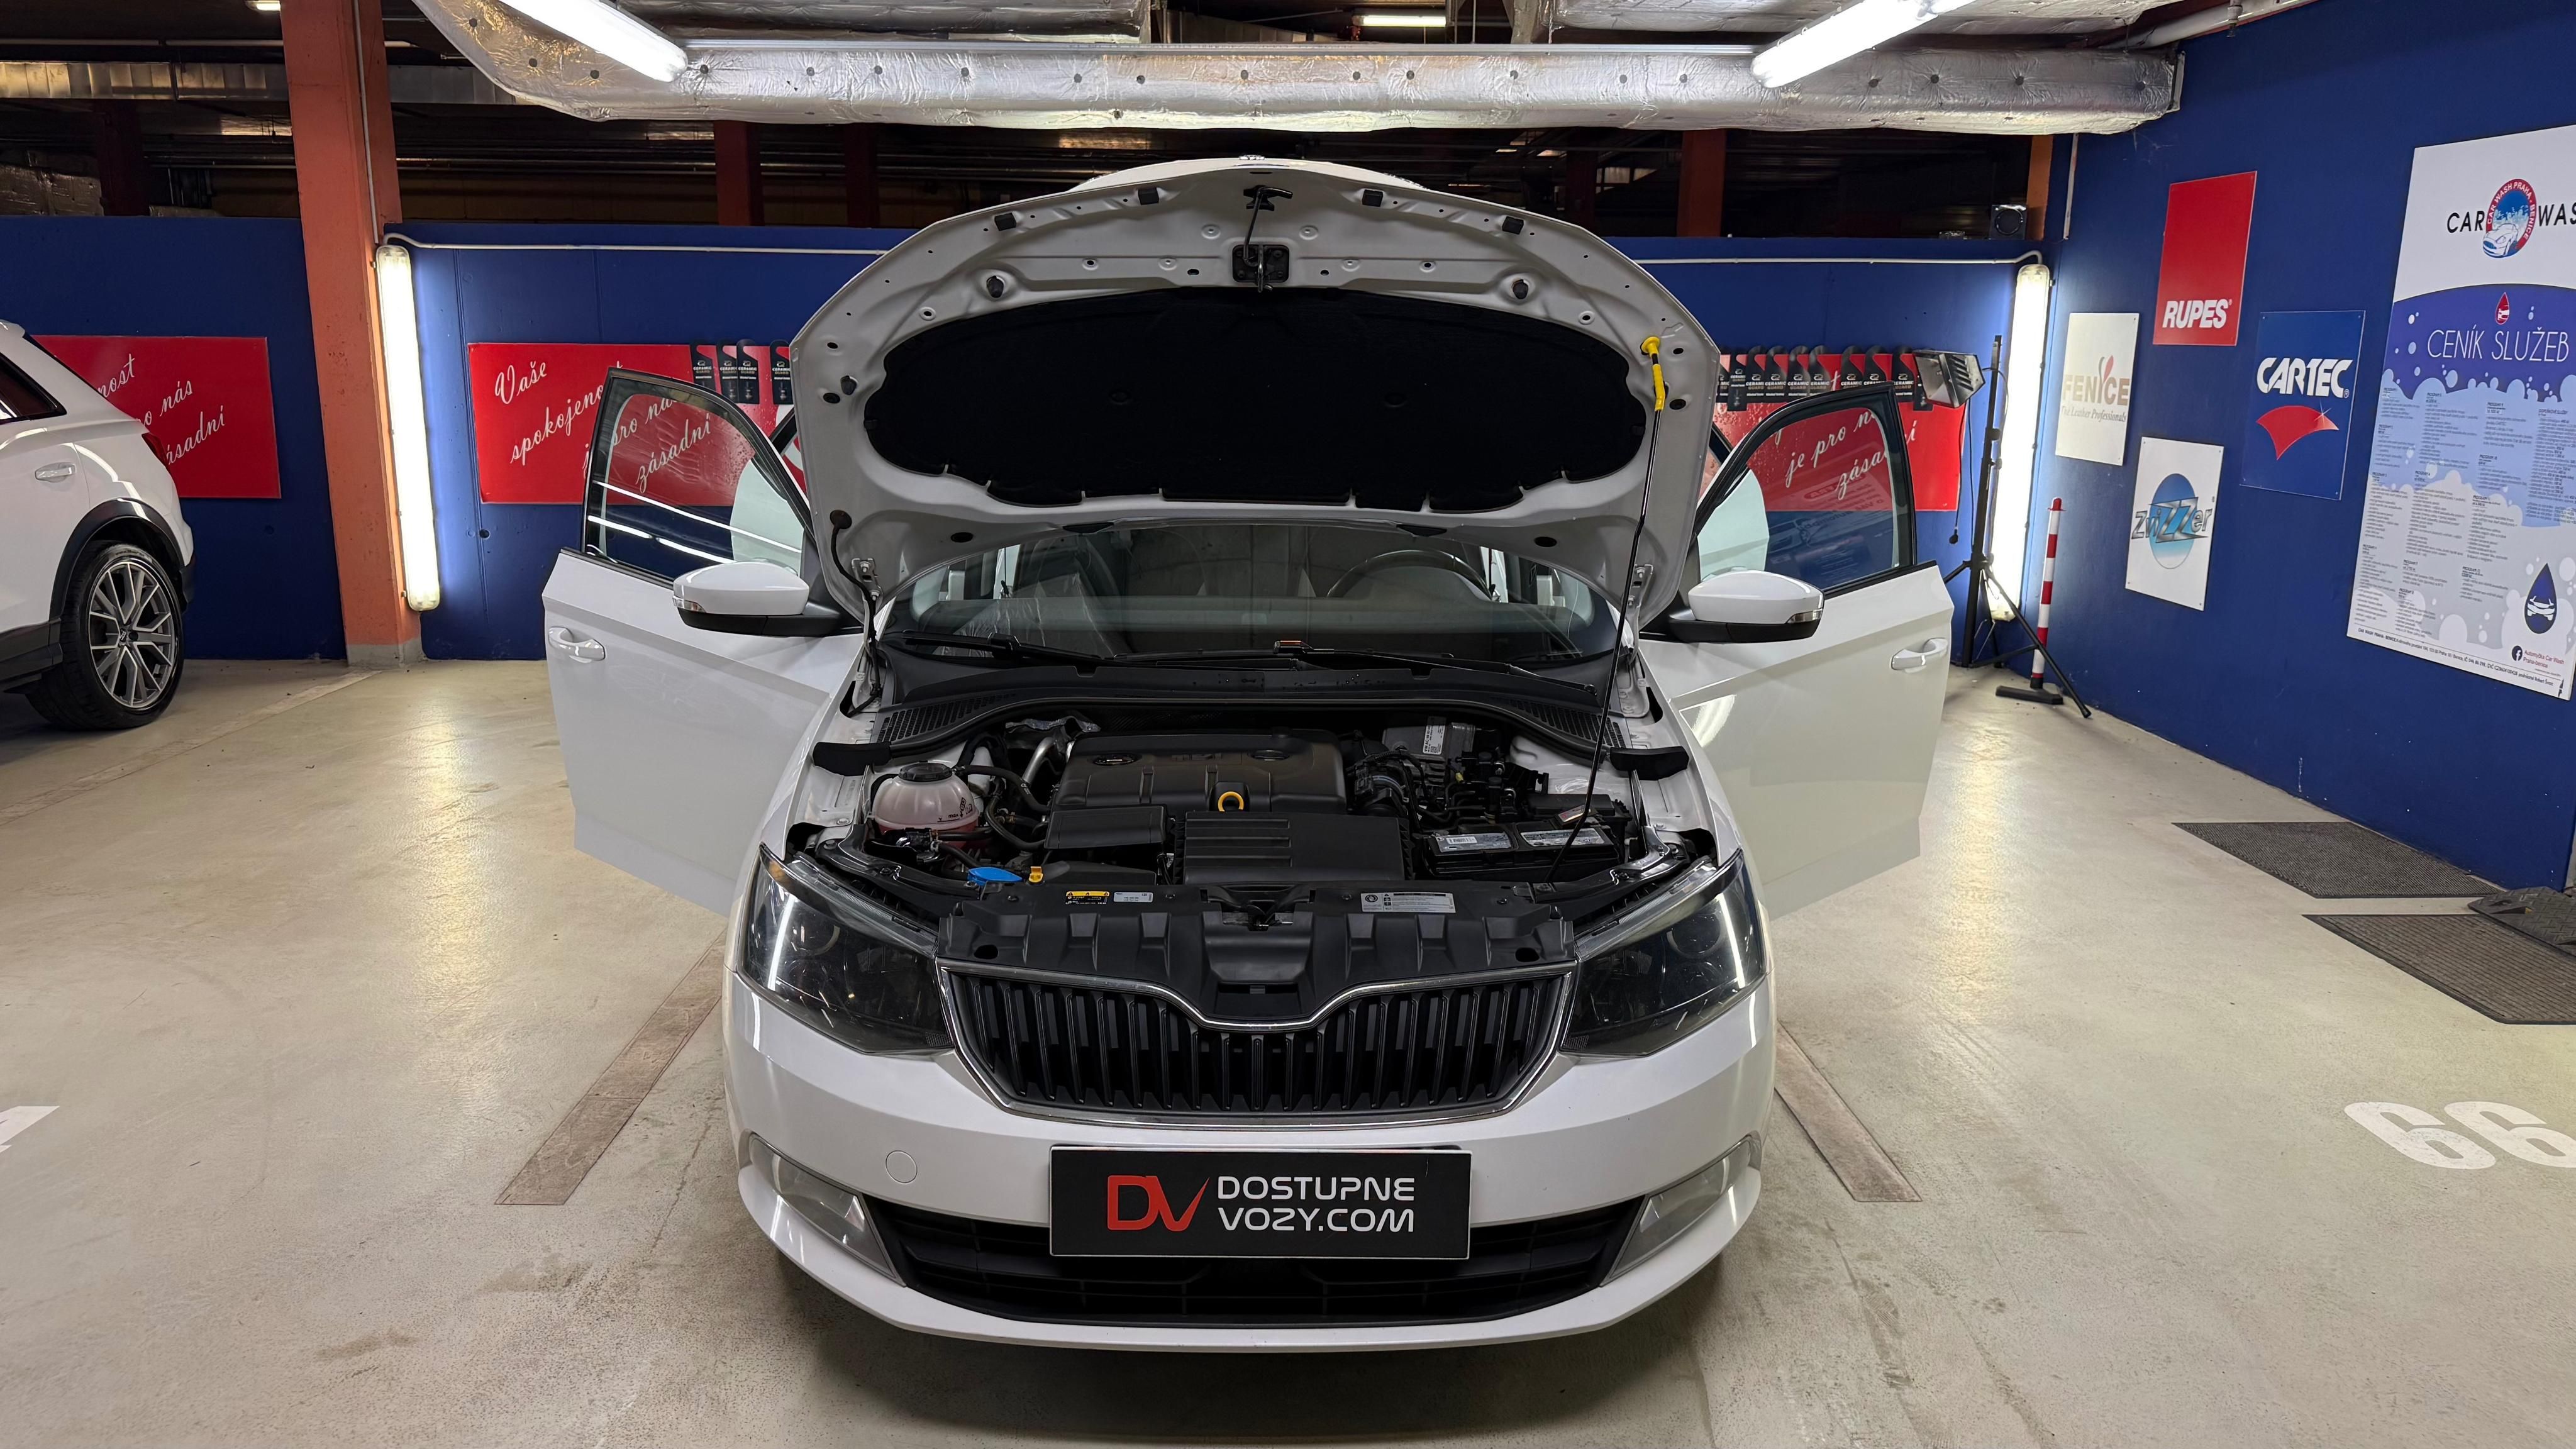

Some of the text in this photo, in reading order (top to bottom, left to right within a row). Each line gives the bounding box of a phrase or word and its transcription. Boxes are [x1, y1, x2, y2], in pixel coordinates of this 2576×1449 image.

[2446, 203, 2576, 233] CAR WAS
[2487, 181, 2536, 240] CAR WASH PRAHA BENICE
[2162, 299, 2229, 329] RUPES
[2428, 324, 2569, 362] CENÍK SLUŽEB
[160, 380, 192, 417] nás
[494, 361, 547, 404] Vaše
[2063, 374, 2130, 406] FENICE
[2257, 357, 2353, 399] CARTEC
[167, 405, 225, 465] ásadní
[510, 384, 605, 466] spokojeno
[635, 413, 711, 494] zásadní
[1785, 452, 1805, 488] je
[1811, 426, 1846, 468] pro
[2344, 1101, 2576, 1169] 66
[1107, 1175, 1210, 1232] DV
[1218, 1177, 1415, 1202] DOSTUPNE
[1218, 1208, 1414, 1233] VOZY.COM
